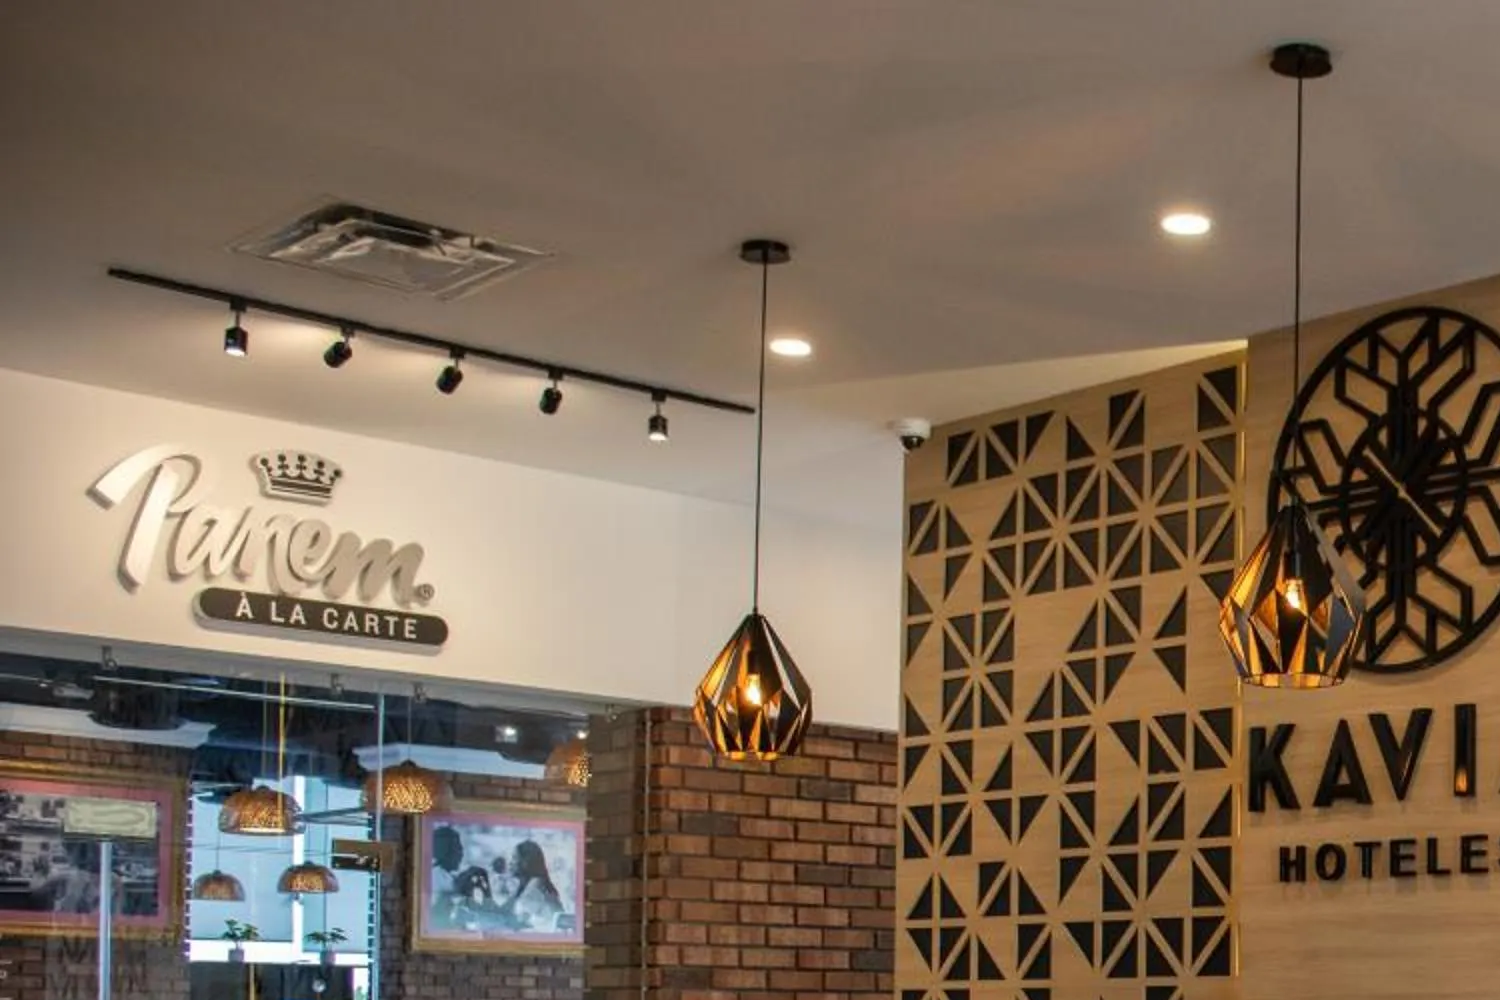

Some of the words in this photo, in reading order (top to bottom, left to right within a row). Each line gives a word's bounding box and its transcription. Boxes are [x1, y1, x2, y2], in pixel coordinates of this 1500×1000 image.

[236, 592, 253, 618] À
[270, 601, 307, 625] LA
[323, 607, 417, 639] CARTE
